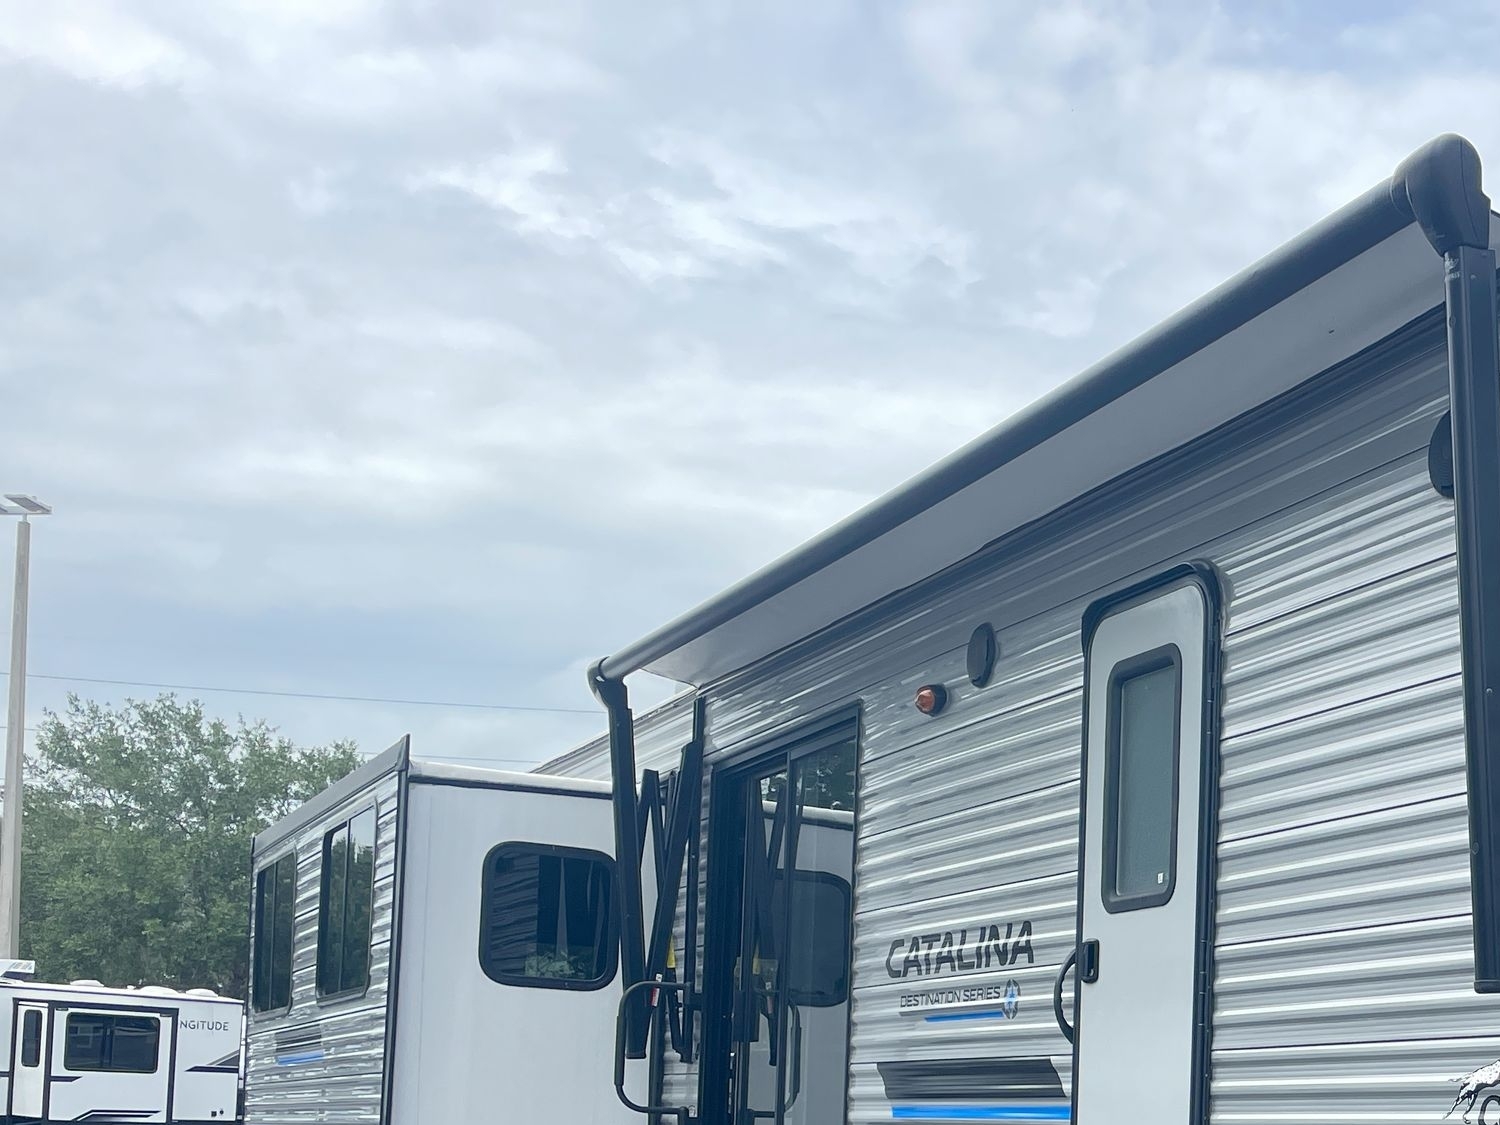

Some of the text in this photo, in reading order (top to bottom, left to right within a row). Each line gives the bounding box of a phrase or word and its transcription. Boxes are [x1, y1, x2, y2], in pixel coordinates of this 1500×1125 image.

[885, 920, 1035, 979] CATALINA
[900, 986, 1001, 1008] DESTINATION SERIES
